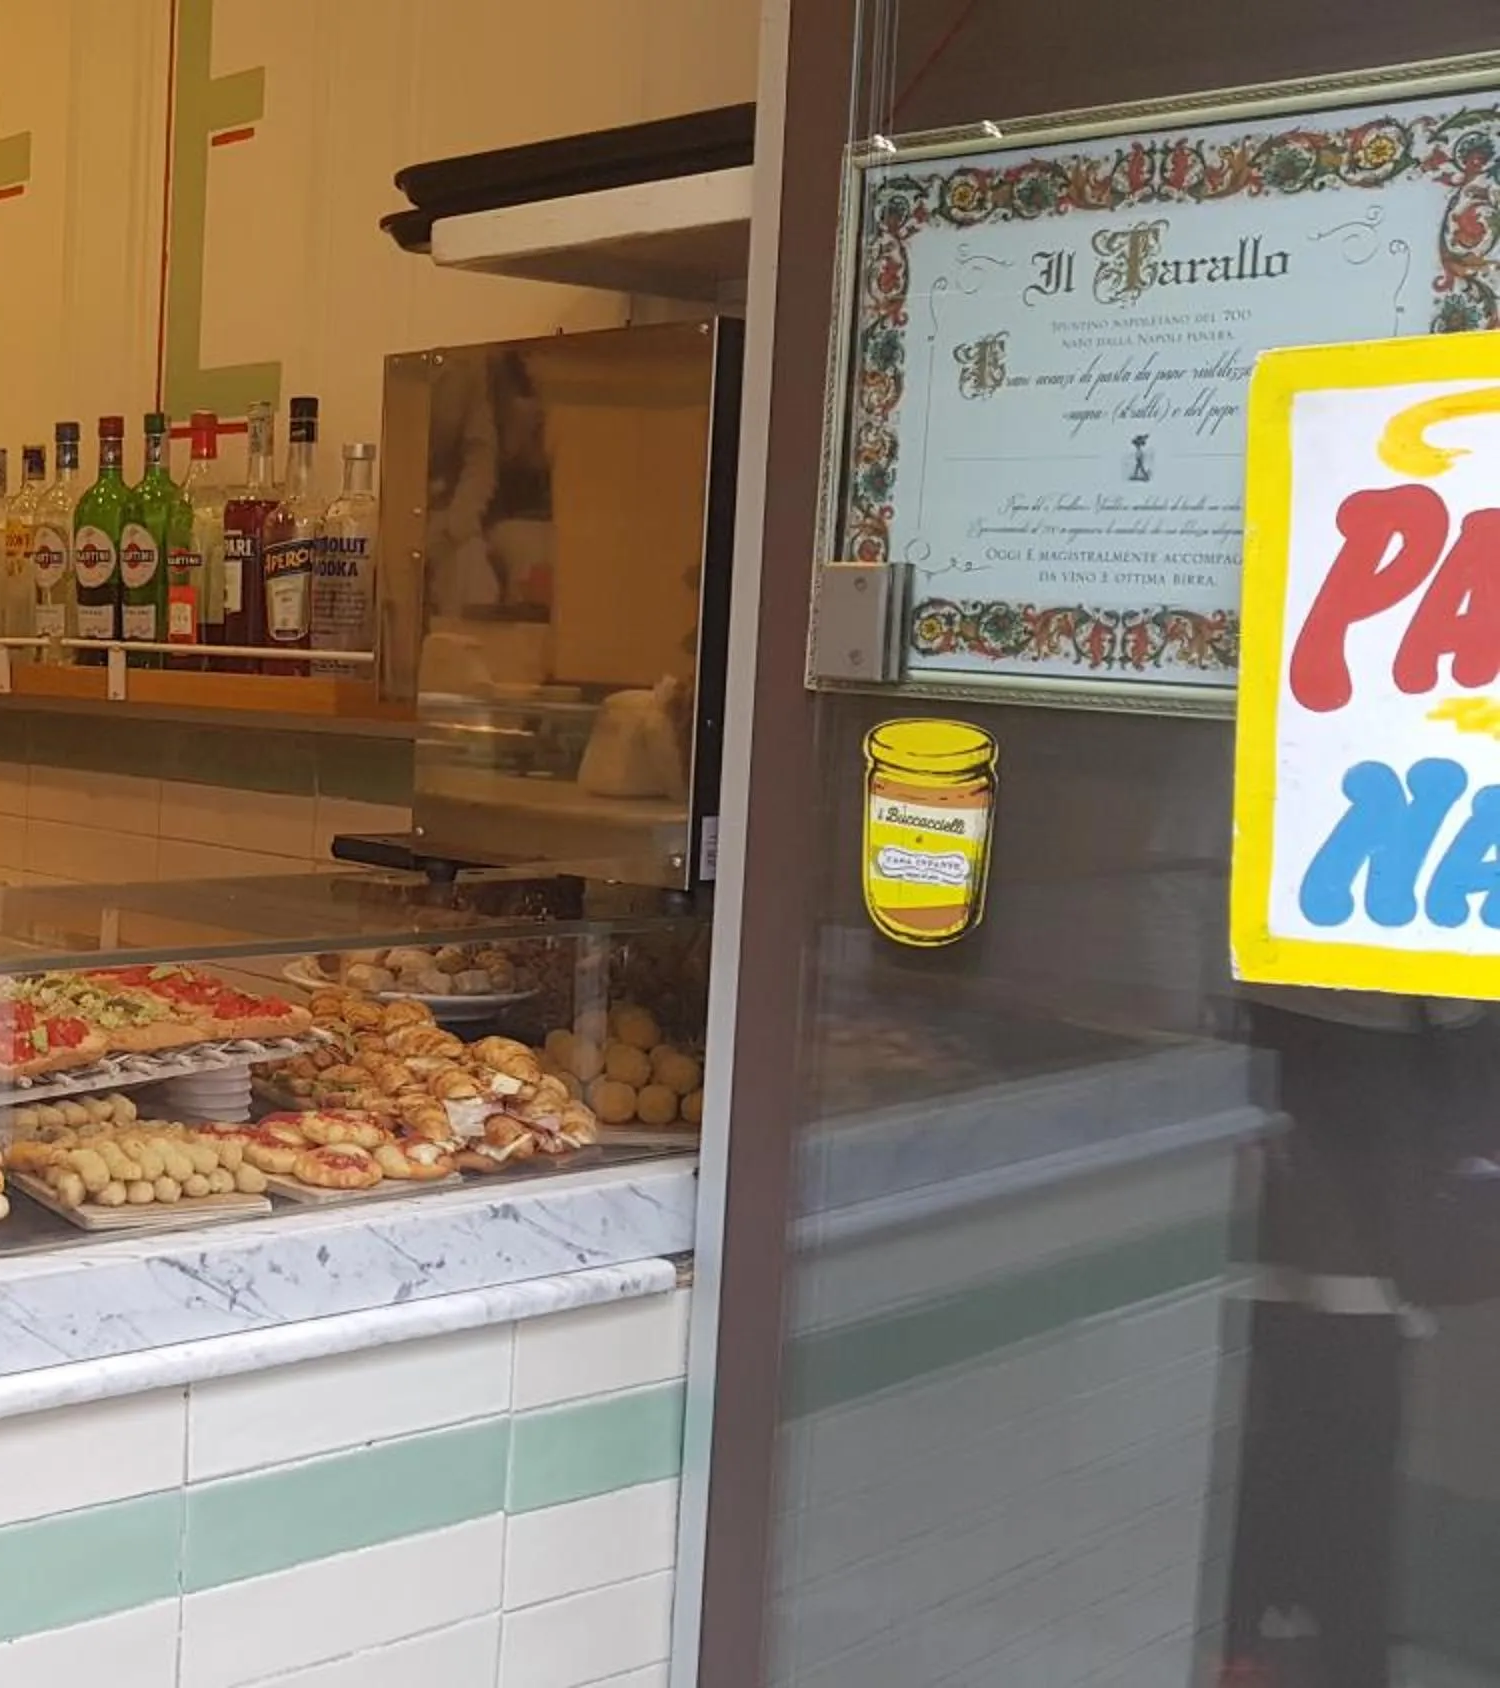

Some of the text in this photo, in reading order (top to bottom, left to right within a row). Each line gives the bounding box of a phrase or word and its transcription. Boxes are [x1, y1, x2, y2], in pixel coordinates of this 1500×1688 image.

[1022, 219, 1292, 309] Il Tarallo
[1163, 552, 1243, 565] ACCOMPAG
